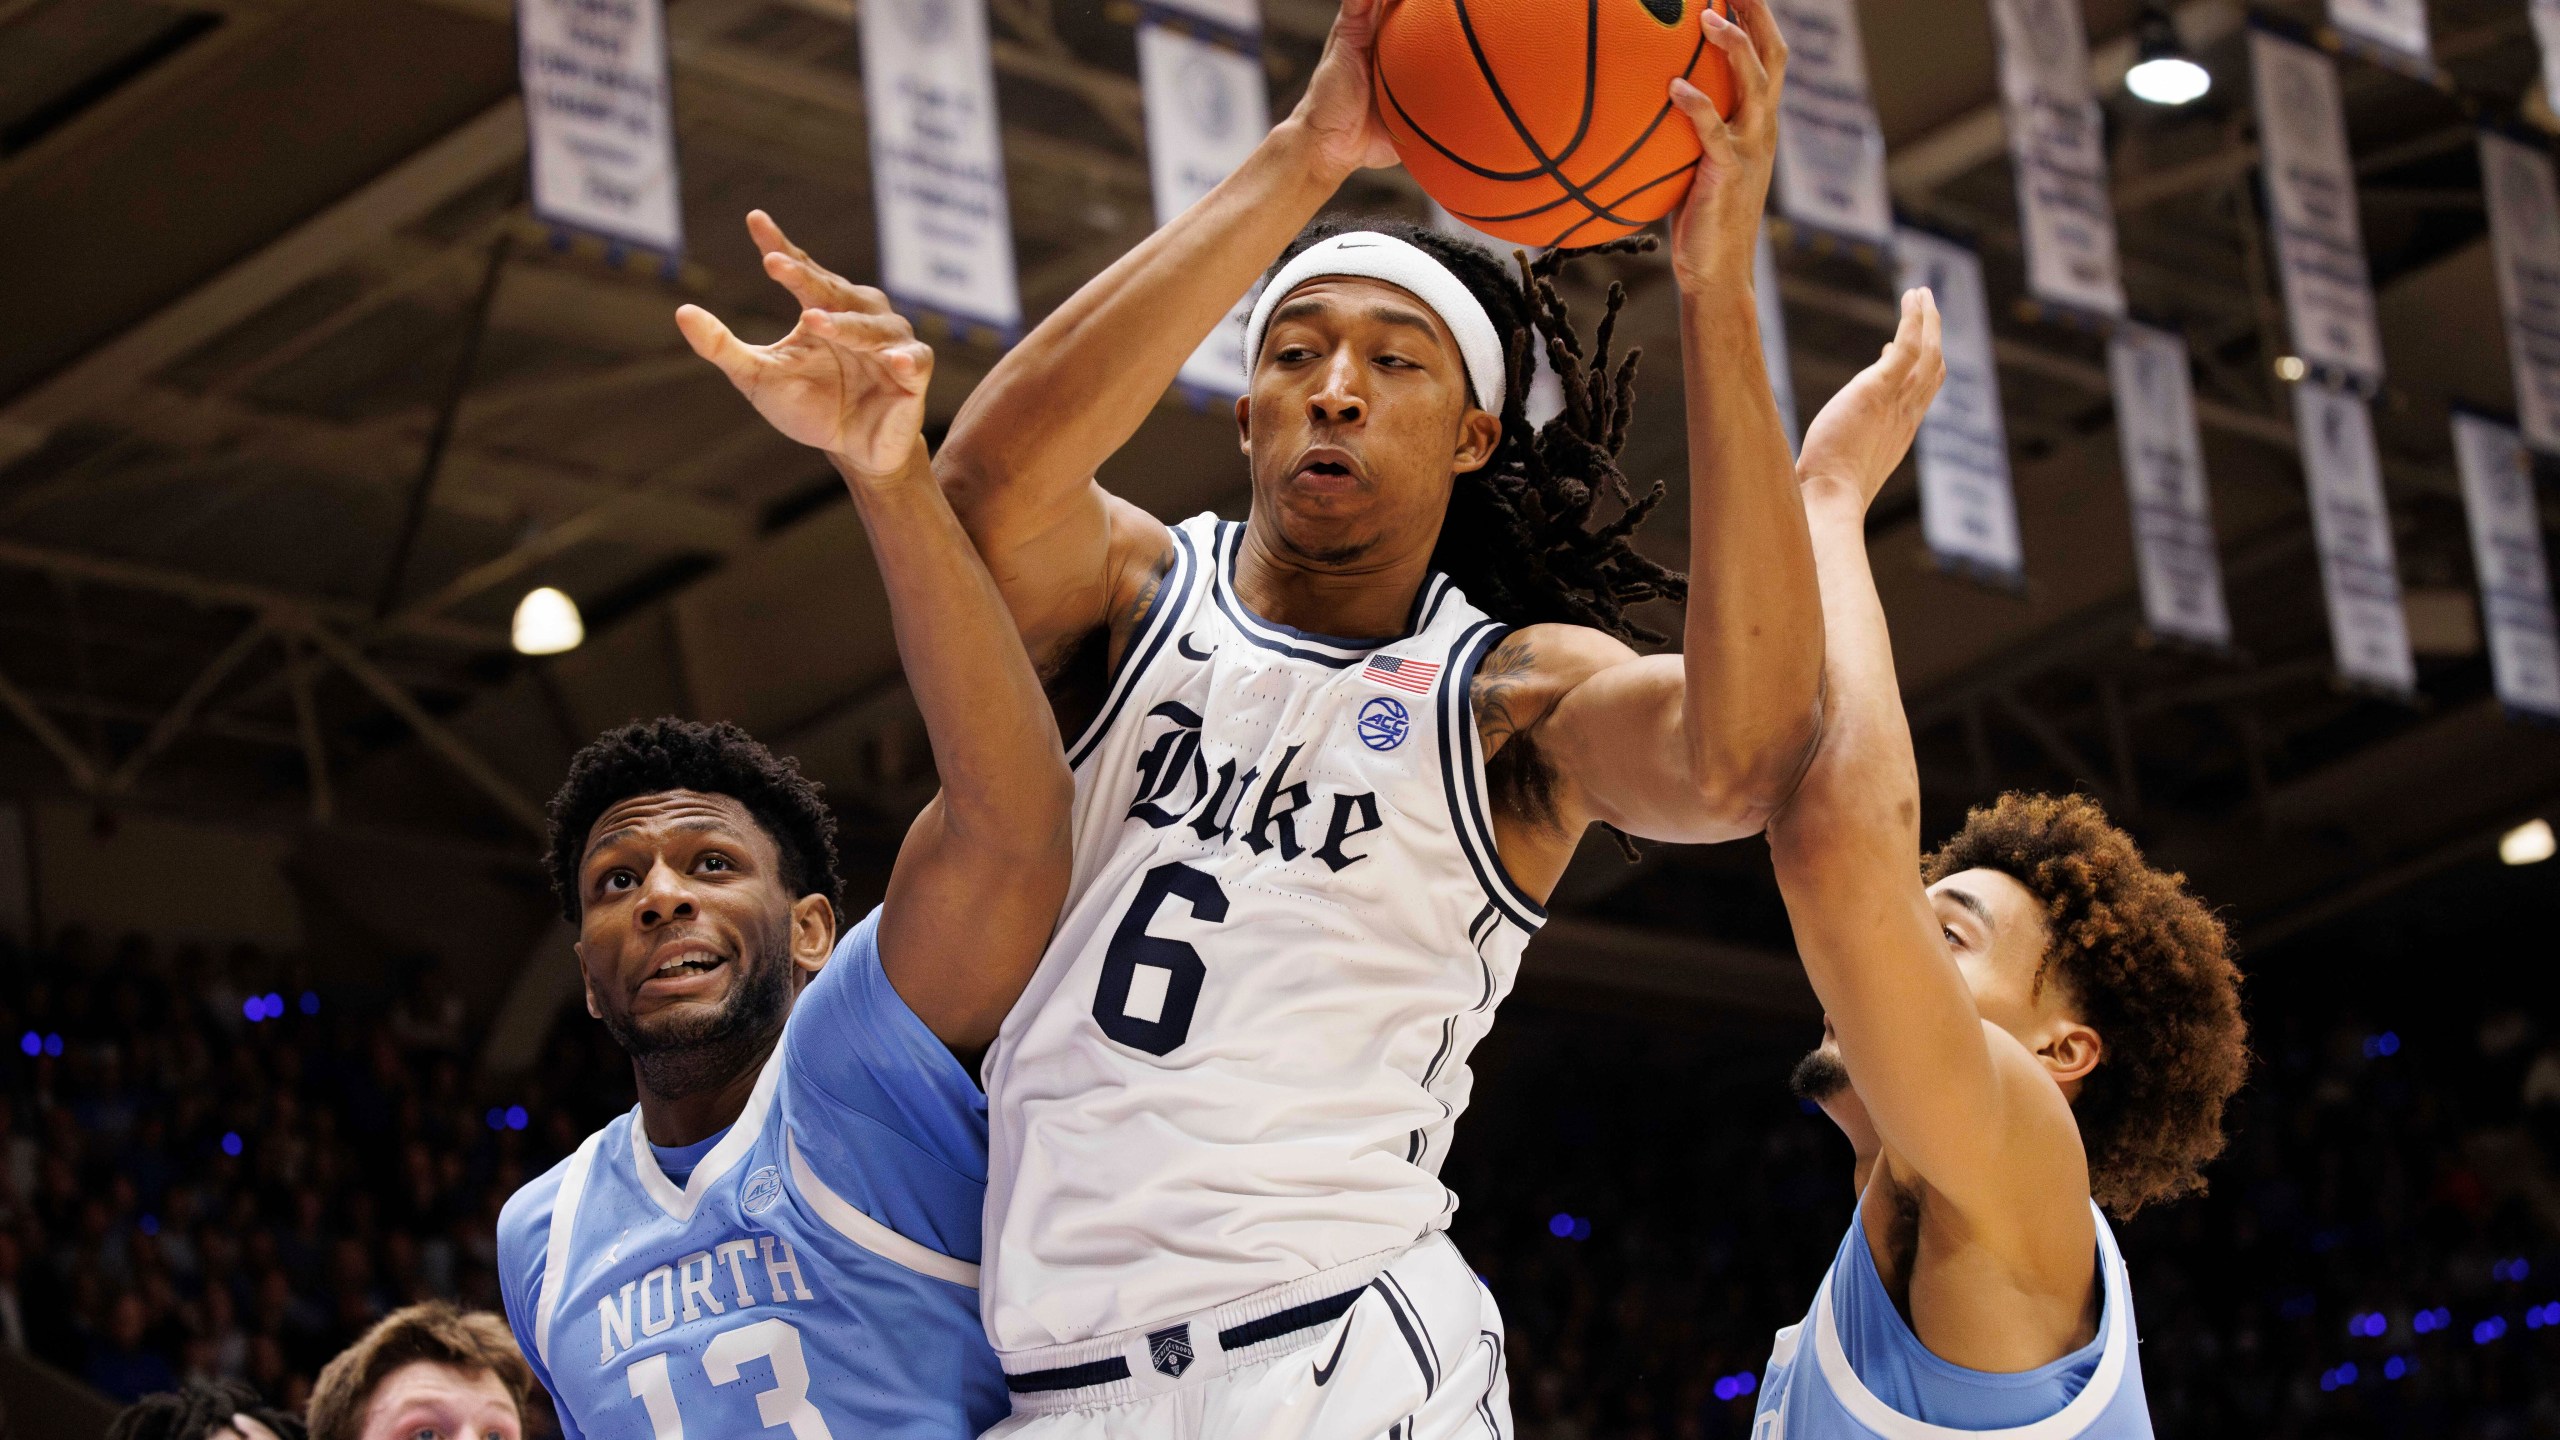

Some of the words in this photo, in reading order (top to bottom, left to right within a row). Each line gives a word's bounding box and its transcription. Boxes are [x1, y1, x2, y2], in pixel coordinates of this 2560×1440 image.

[1125, 700, 1384, 873] Duke
[1364, 713, 1409, 735] ACC
[1091, 861, 1231, 1057] 6
[597, 1235, 815, 1367] NORTH
[626, 1317, 834, 1440] 13
